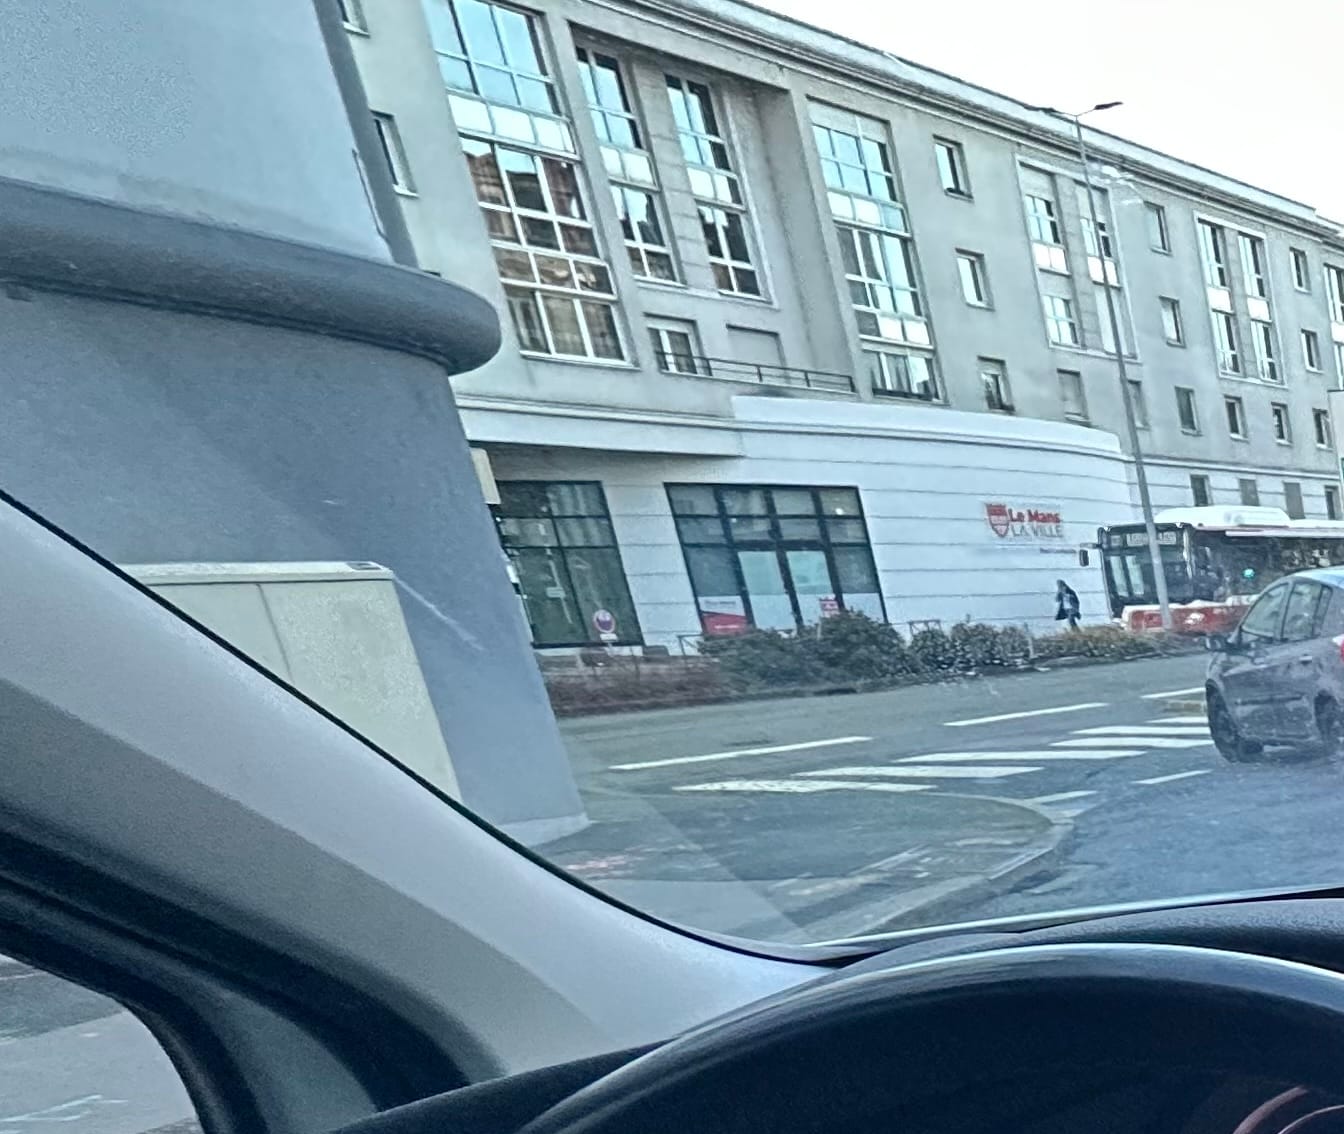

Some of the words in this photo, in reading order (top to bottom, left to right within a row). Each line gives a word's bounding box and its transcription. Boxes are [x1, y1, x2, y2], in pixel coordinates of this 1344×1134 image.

[1008, 508, 1025, 523] Le
[1027, 508, 1061, 524] Mans
[1011, 523, 1030, 537] LA
[1033, 524, 1064, 538] VILLE
